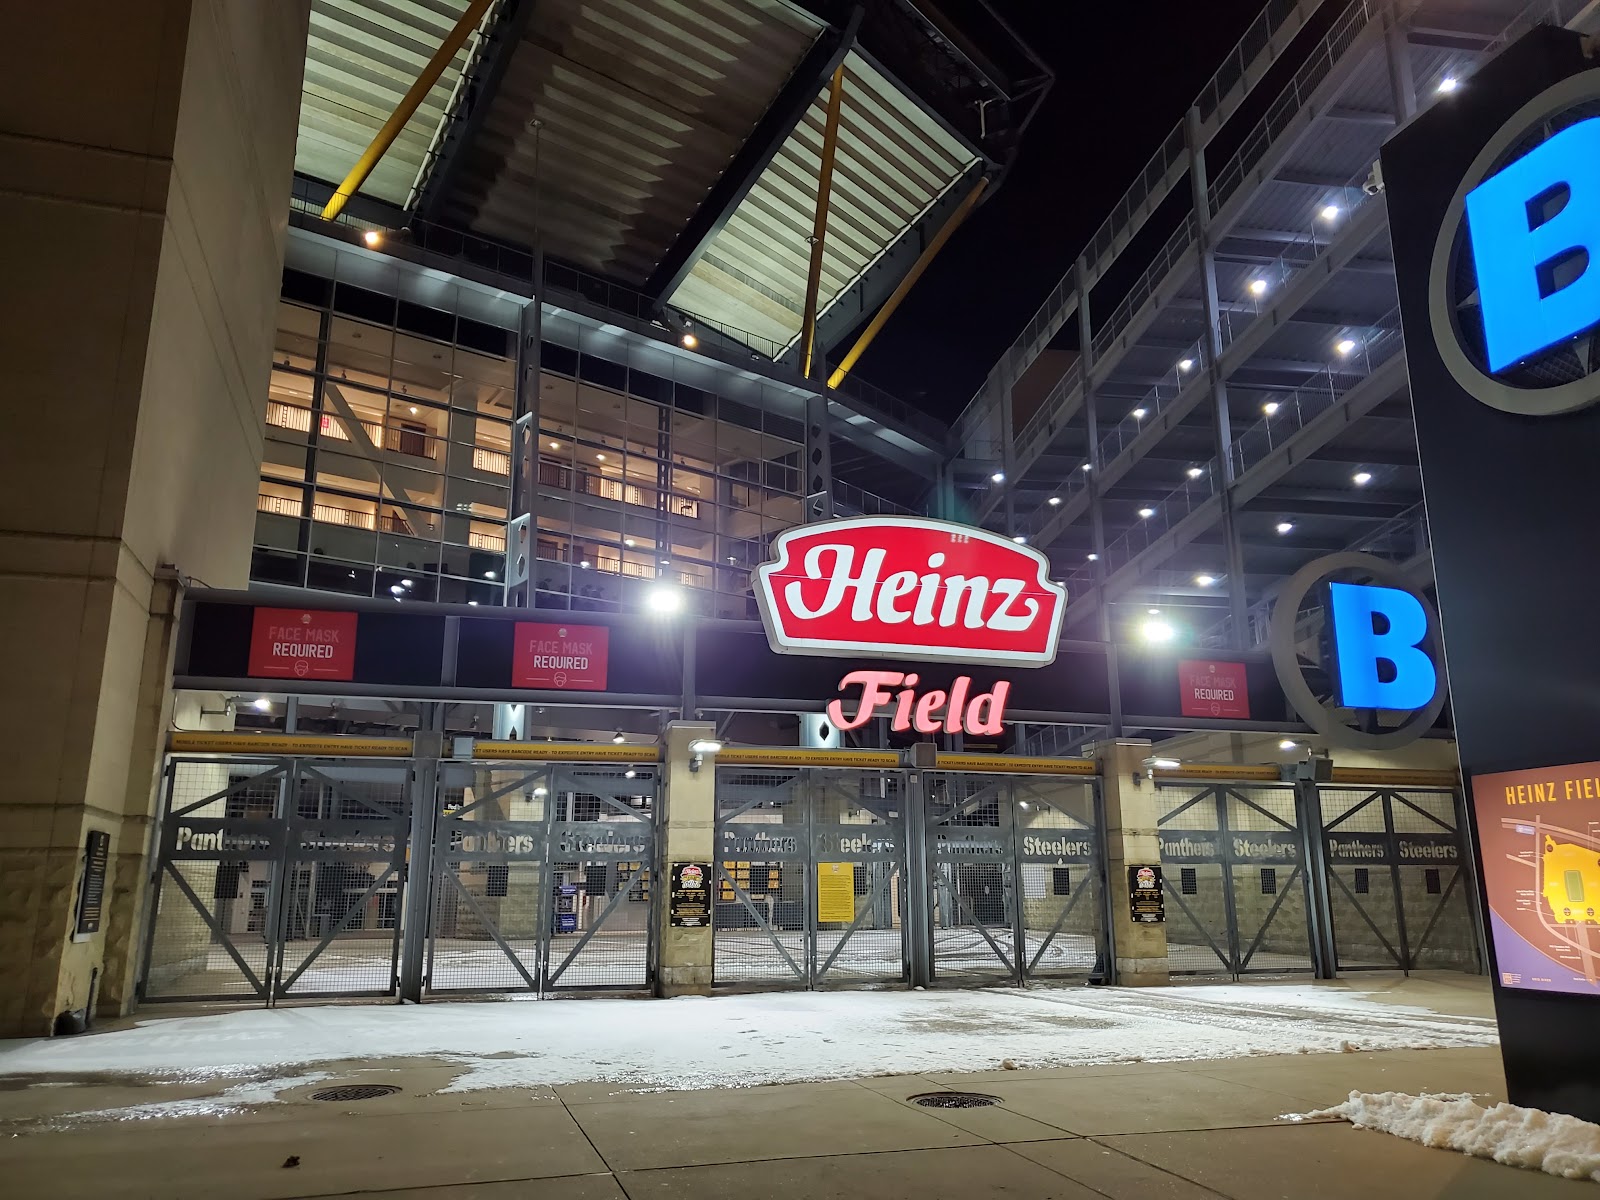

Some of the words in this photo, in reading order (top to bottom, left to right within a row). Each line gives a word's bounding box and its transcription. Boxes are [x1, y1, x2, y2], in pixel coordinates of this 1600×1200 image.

[1464, 115, 1600, 374] B
[784, 544, 1039, 632] Heinz
[269, 626, 302, 640] FACE
[305, 628, 340, 643] MASK
[272, 642, 334, 659] REQUIRED
[529, 640, 559, 654] FACE
[562, 642, 593, 655] MASK
[1330, 582, 1437, 710] B
[533, 655, 589, 670] REQUIRED
[826, 670, 1011, 736] Field
[1194, 688, 1234, 701] REQUIRED
[1505, 782, 1557, 805] HEINZ
[1023, 836, 1093, 856] Steelers
[1233, 838, 1297, 858] Steelers
[1329, 839, 1385, 858] Panthers
[1398, 840, 1458, 859] Steelers
